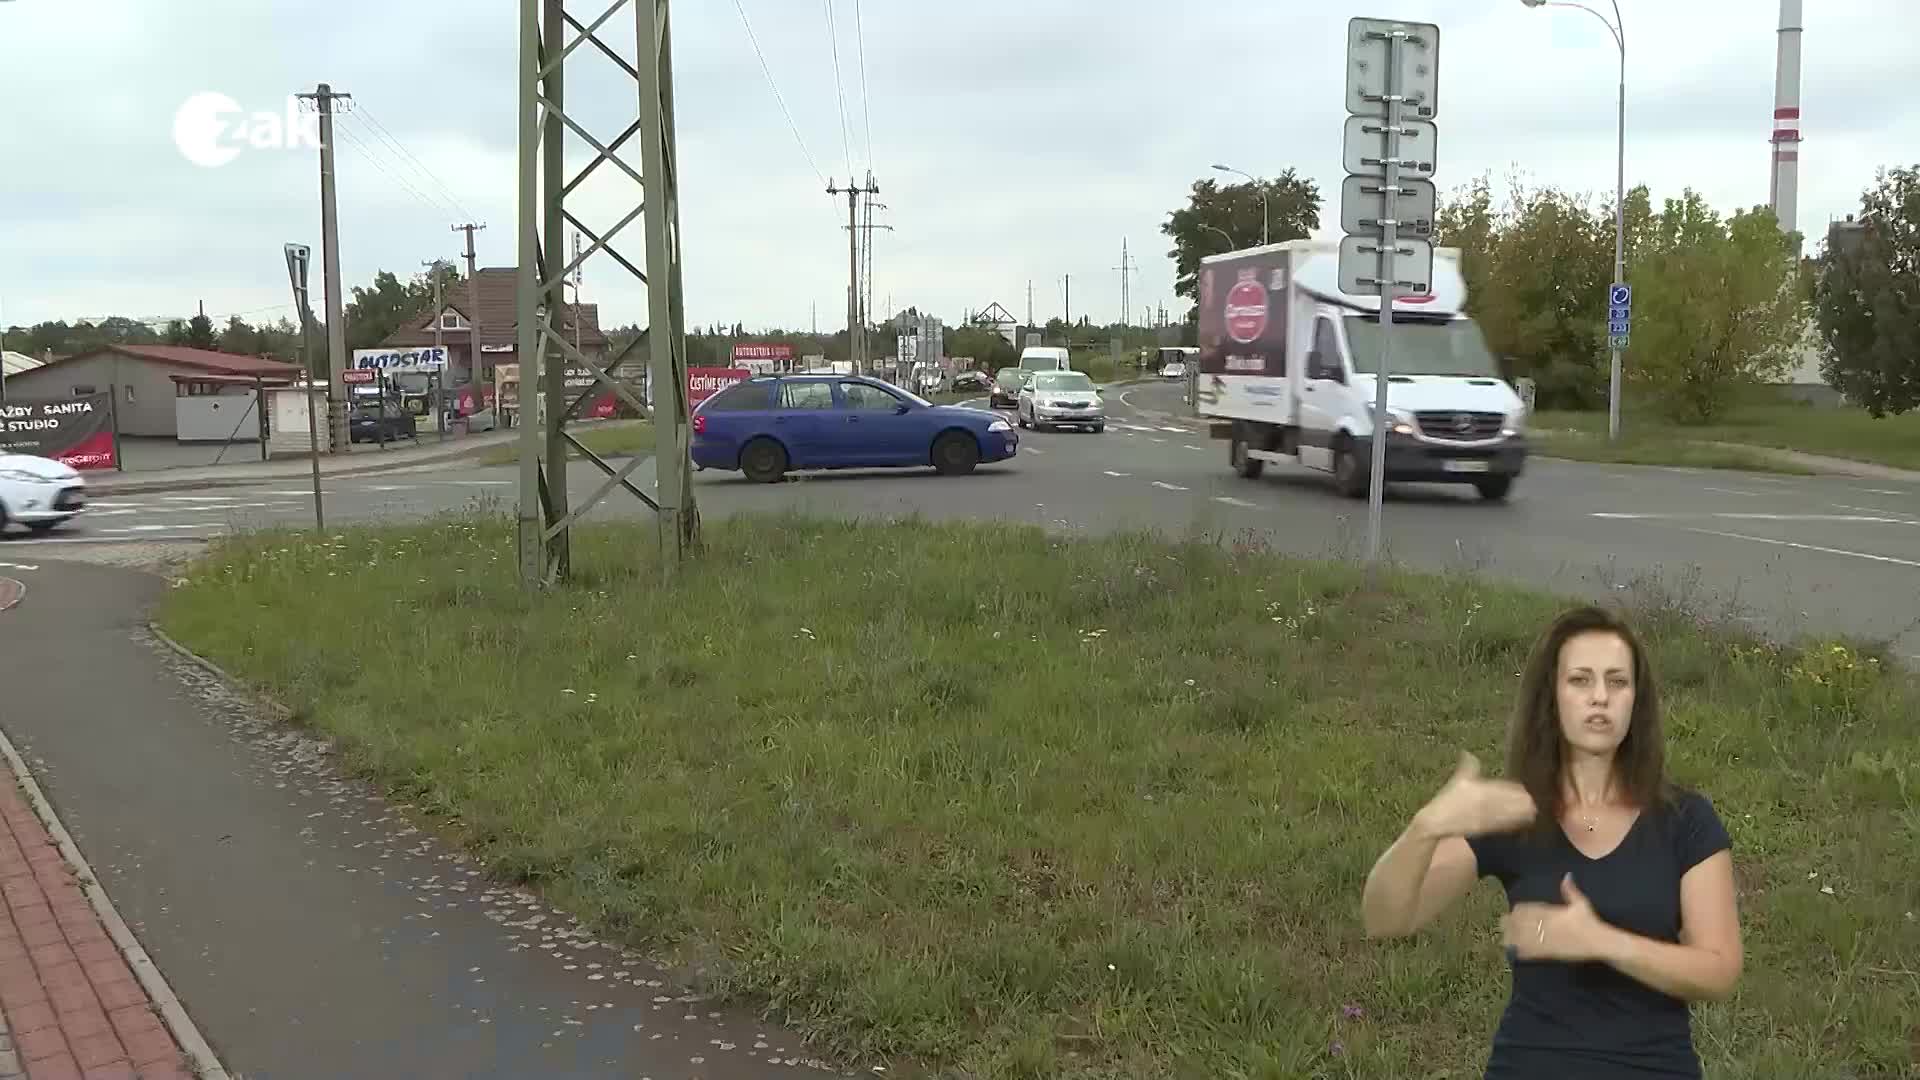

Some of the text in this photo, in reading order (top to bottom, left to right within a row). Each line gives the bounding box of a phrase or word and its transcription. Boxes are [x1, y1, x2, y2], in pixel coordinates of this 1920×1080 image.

[358, 348, 444, 369] AUTOSTAR
[43, 401, 93, 415] SANITA
[8, 419, 59, 432] STUDIO
